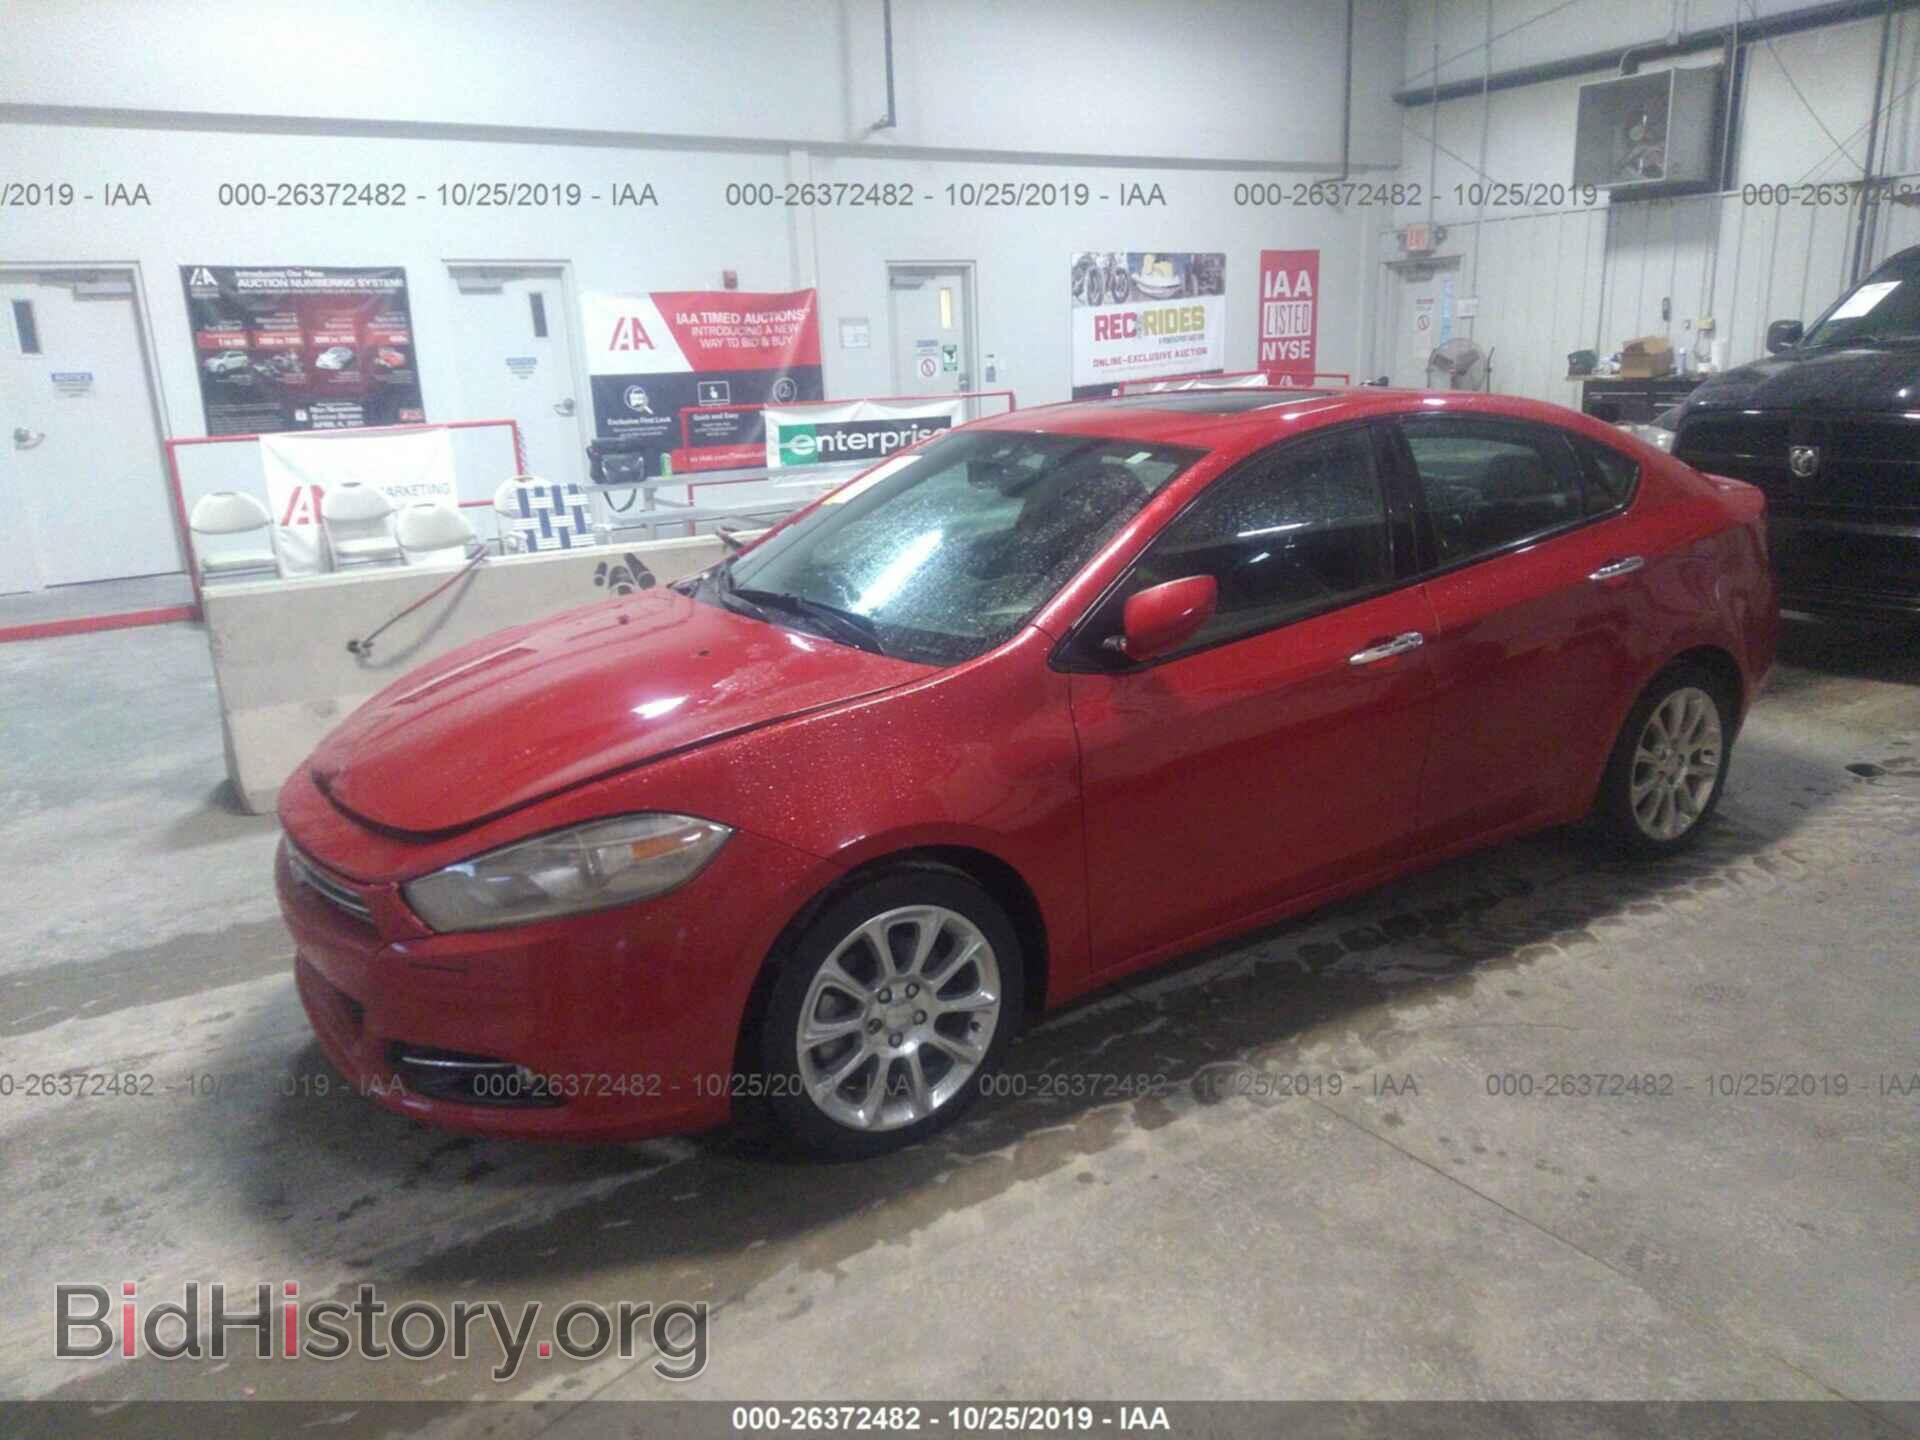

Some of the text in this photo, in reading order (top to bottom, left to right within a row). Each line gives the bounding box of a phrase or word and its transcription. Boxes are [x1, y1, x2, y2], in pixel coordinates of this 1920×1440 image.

[237, 278, 289, 288] AUCTION
[290, 278, 356, 288] NUMBERING
[1263, 270, 1313, 298] IAA
[676, 312, 701, 325] IAA
[700, 311, 741, 325] TIMED
[1094, 312, 1138, 341] REC
[1143, 306, 1205, 337] RIDES
[1265, 303, 1309, 336] LISTED
[691, 325, 763, 337] INTRODUCING
[774, 322, 799, 335] NEW
[698, 337, 725, 348] WAY
[725, 337, 740, 347] TO
[740, 336, 760, 347] BID
[770, 334, 793, 346] BUY
[1092, 352, 1174, 368] ONLINE-EXCLUSIVE
[1174, 347, 1208, 359] AUCTION
[1261, 340, 1311, 361] NYSE
[381, 482, 451, 498] ARKETING
